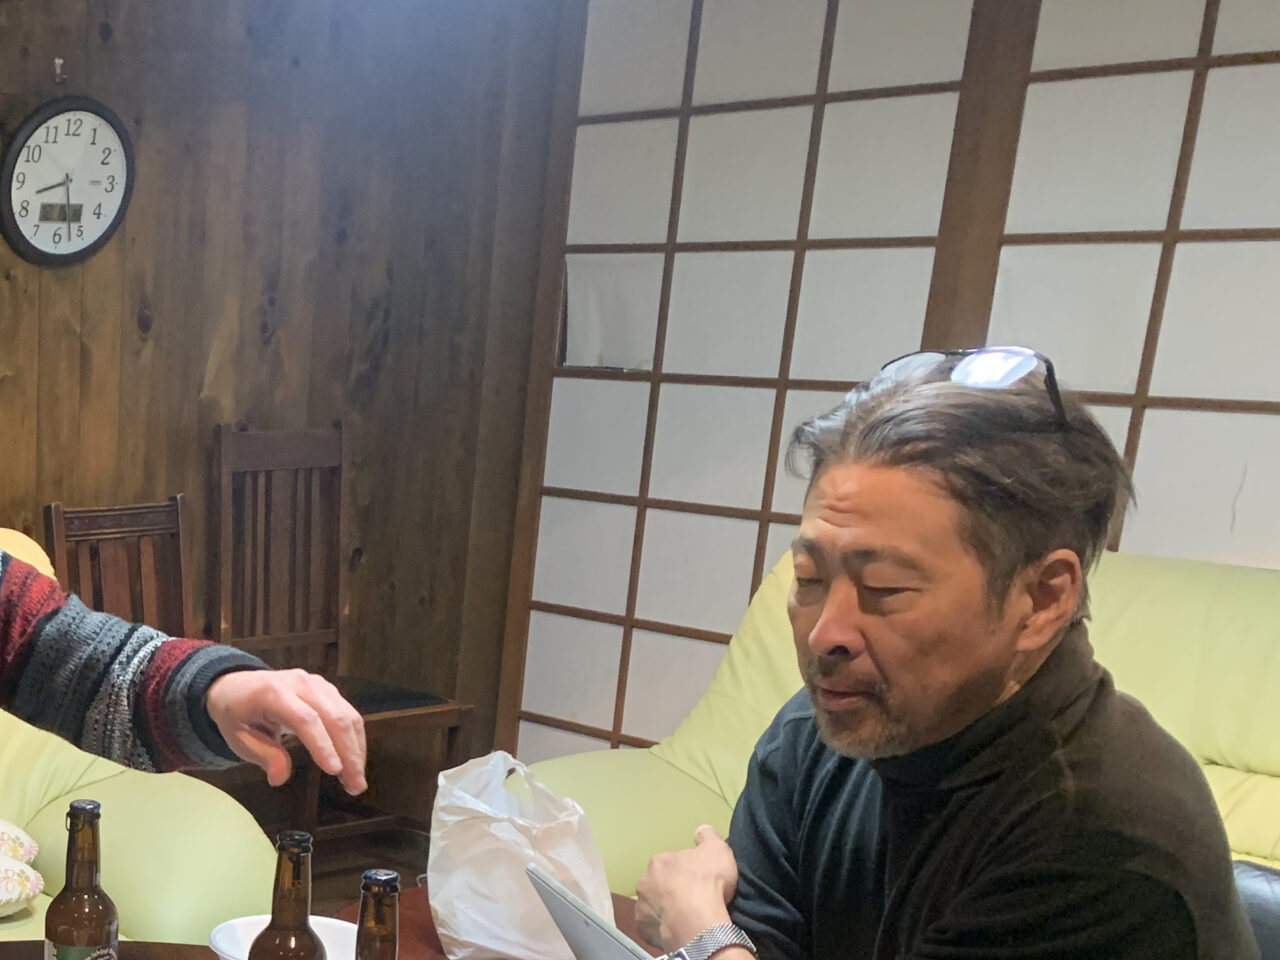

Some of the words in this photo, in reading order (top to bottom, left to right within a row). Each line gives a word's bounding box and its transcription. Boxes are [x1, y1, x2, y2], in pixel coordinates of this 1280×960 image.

[43, 126, 59, 144] 11
[64, 118, 83, 137] 12
[90, 128, 98, 145] 1
[24, 144, 42, 163] 10
[101, 147, 112, 165] 2
[16, 172, 26, 190] 9
[104, 175, 115, 193] 3
[18, 199, 30, 218] 8
[92, 202, 102, 219] 4
[32, 224, 40, 237] 7
[52, 226, 62, 244] 6
[76, 225, 83, 237] 5
